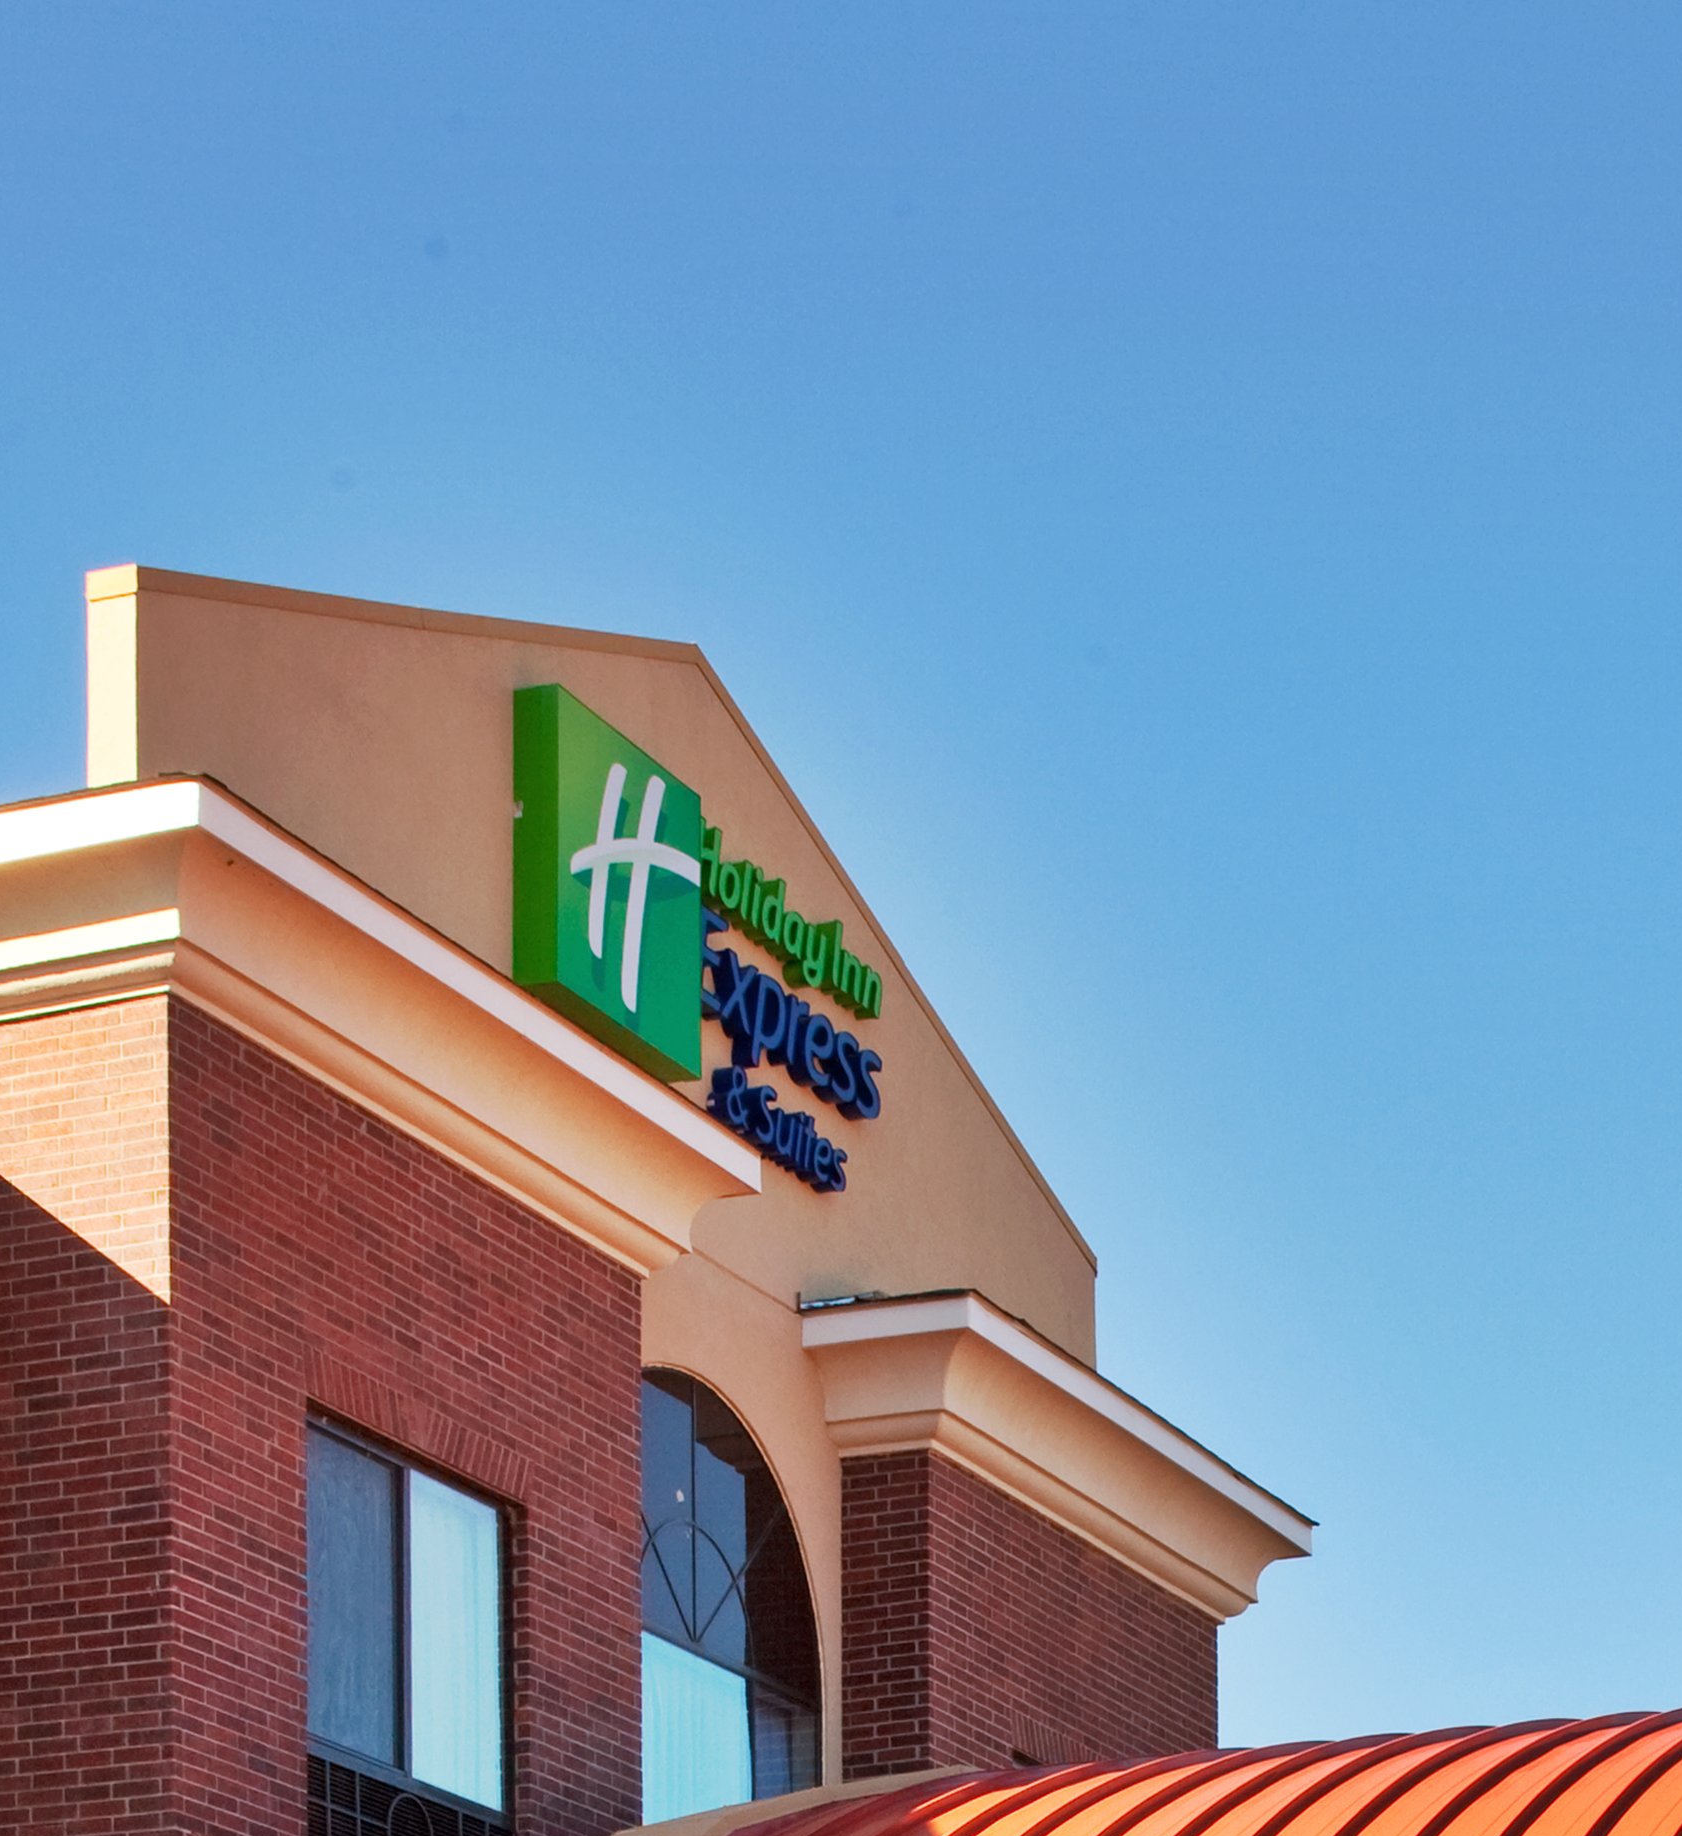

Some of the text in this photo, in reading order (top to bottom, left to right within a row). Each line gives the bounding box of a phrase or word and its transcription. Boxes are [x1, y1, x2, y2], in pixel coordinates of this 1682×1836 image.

[829, 920, 883, 1019] Inn
[718, 1065, 849, 1192] & Suites
